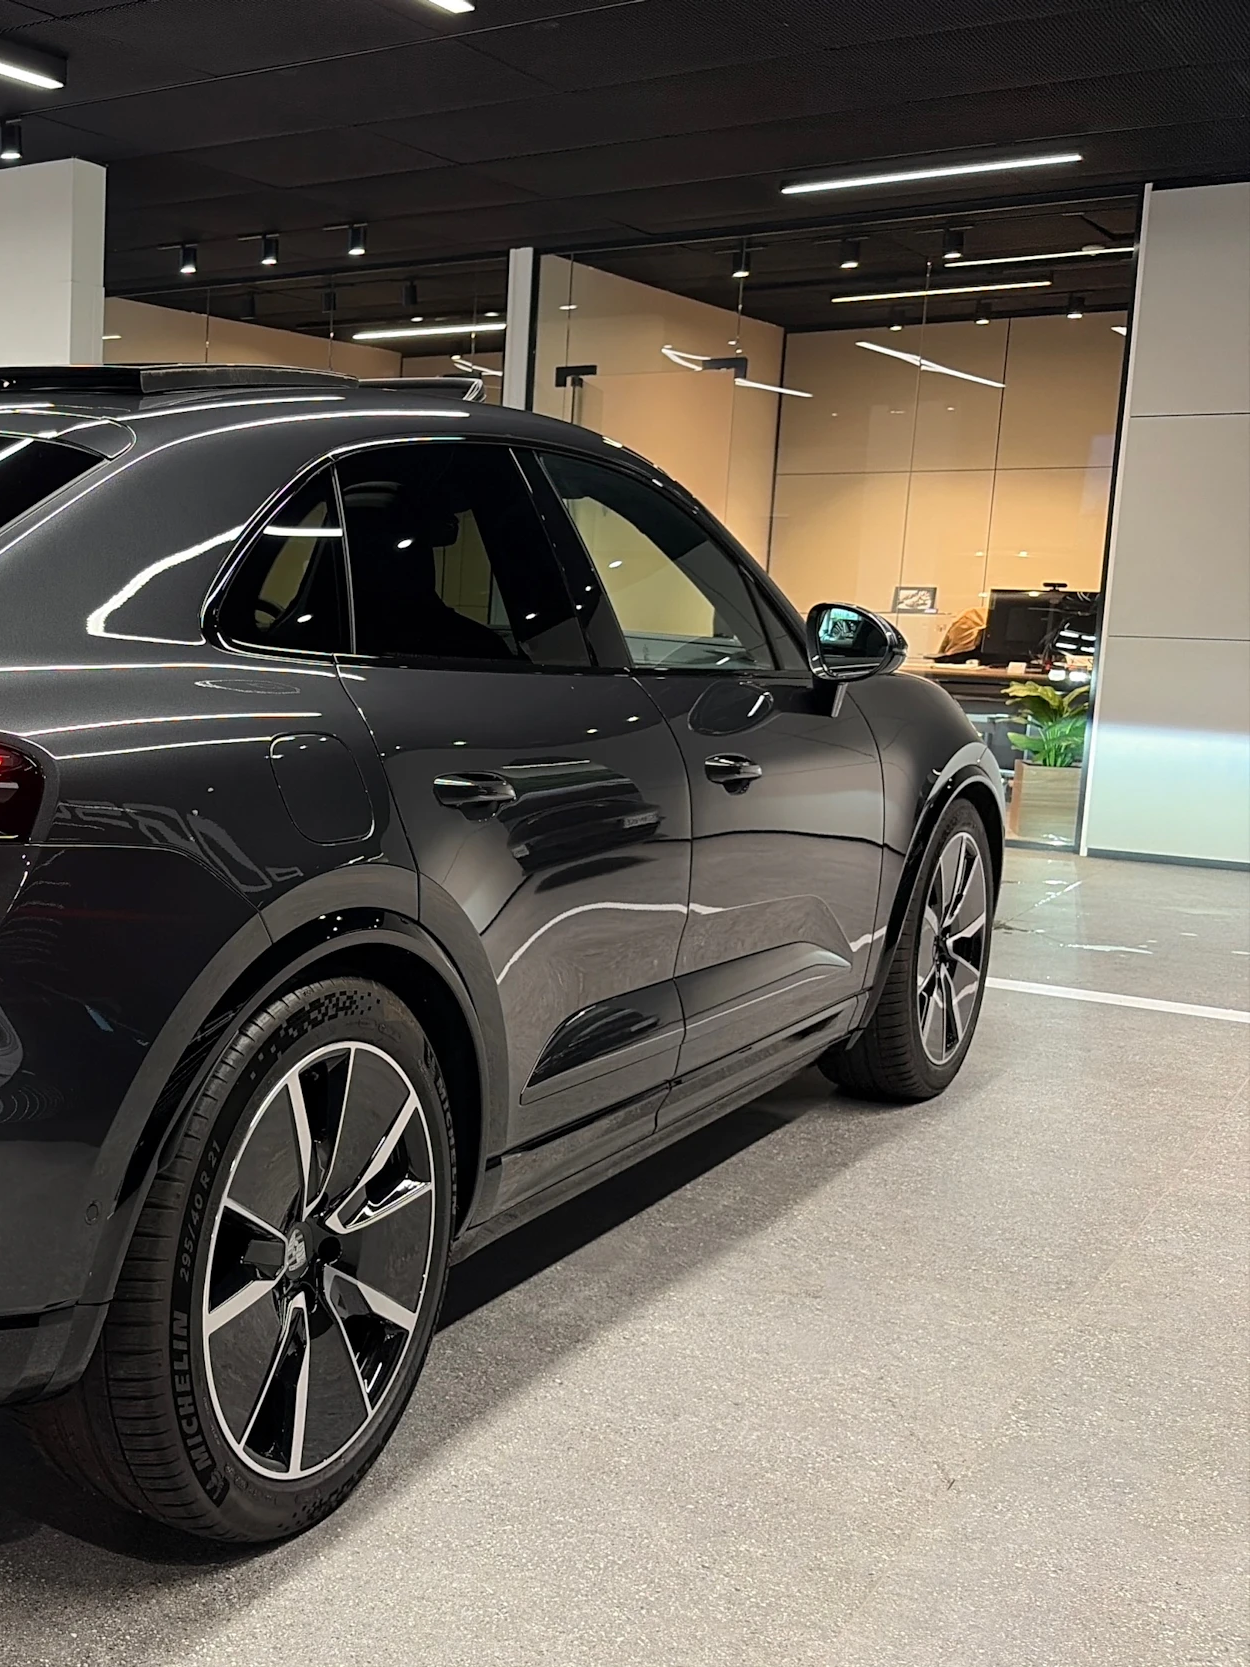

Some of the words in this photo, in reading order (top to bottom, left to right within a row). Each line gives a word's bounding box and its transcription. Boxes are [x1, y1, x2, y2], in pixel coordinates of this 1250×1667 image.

[180, 1193, 203, 1283] 295/40
[199, 1170, 210, 1190] R
[208, 1139, 221, 1168] 21
[173, 1310, 213, 1472] MICHELIN
